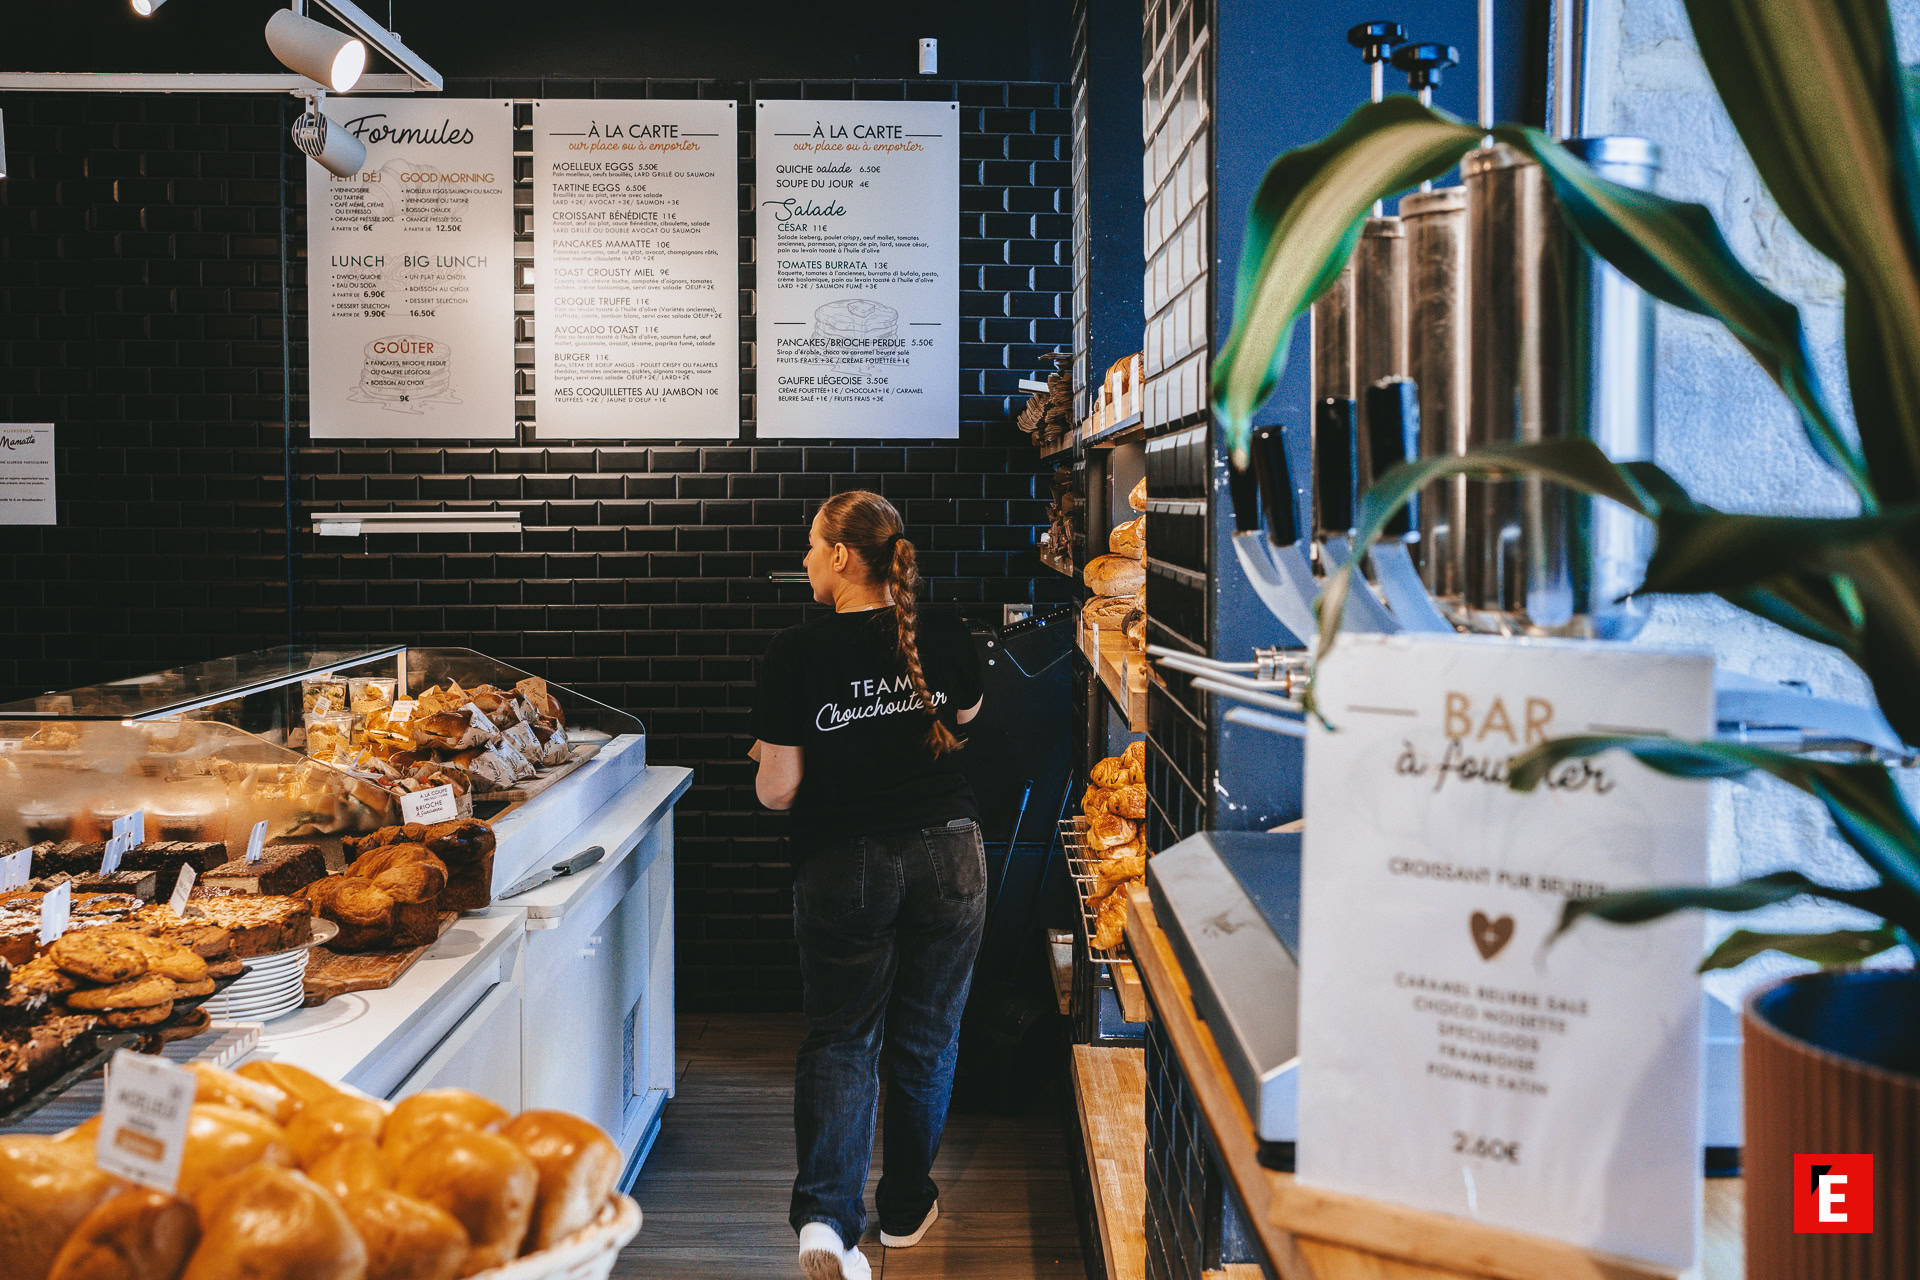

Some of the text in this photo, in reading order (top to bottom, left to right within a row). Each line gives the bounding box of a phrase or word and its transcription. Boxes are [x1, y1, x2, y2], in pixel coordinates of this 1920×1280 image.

[344, 114, 473, 144] Formules
[588, 121, 678, 138] À LA CARTE
[813, 121, 902, 138] À LA CARTE
[569, 142, 589, 150] sur
[590, 140, 619, 153] place
[638, 141, 647, 150] à
[649, 140, 700, 153] emporter
[793, 142, 813, 150] sur
[814, 140, 844, 154] place
[862, 142, 871, 150] à
[873, 141, 924, 154] emporter
[552, 162, 602, 171] MOELLEUX
[606, 163, 633, 171] EGGS
[776, 165, 813, 173] QUICHE
[816, 162, 852, 173] salade
[362, 170, 382, 183] DÉJ
[400, 173, 494, 183] GOOD MORNING
[593, 184, 620, 192] EGGS
[776, 179, 808, 188] SOUPE
[812, 180, 824, 188] DU
[828, 180, 853, 188] JOUR
[553, 212, 606, 220] CROISSANT
[610, 210, 657, 220] BÉNÉDICTE
[762, 198, 846, 221] Salade
[777, 222, 807, 232] CÉSAR
[553, 240, 602, 248] PANCAKES
[606, 240, 650, 248] MAMATTE
[332, 256, 384, 267] LUNCH
[404, 256, 487, 268] BIG LUNCH
[777, 261, 822, 269] TOMATES
[825, 261, 867, 269] BURRATA
[554, 268, 584, 276] TOAST
[588, 268, 630, 276] CROUSTY
[374, 339, 433, 354] GOÛTER
[777, 338, 933, 348] PANCAKES/BRIOCHE PERDUE 5.50€
[555, 353, 590, 361] BURGER
[817, 375, 862, 385] LIÉGEOISE
[866, 377, 889, 385] 3.50€
[554, 388, 573, 396] MES
[576, 388, 642, 396] COQUILLETTES
[645, 388, 659, 396] AU
[662, 388, 703, 396] JAMBON
[851, 674, 914, 698] TEAM
[1444, 691, 1554, 744] BAR
[1395, 741, 1426, 777] à
[431, 788, 448, 796] COUPE
[415, 800, 442, 812] BRIOCHE
[1388, 856, 1491, 888] CROISSANT
[1499, 870, 1530, 891] PUR
[1452, 1129, 1521, 1166] 2.60€
